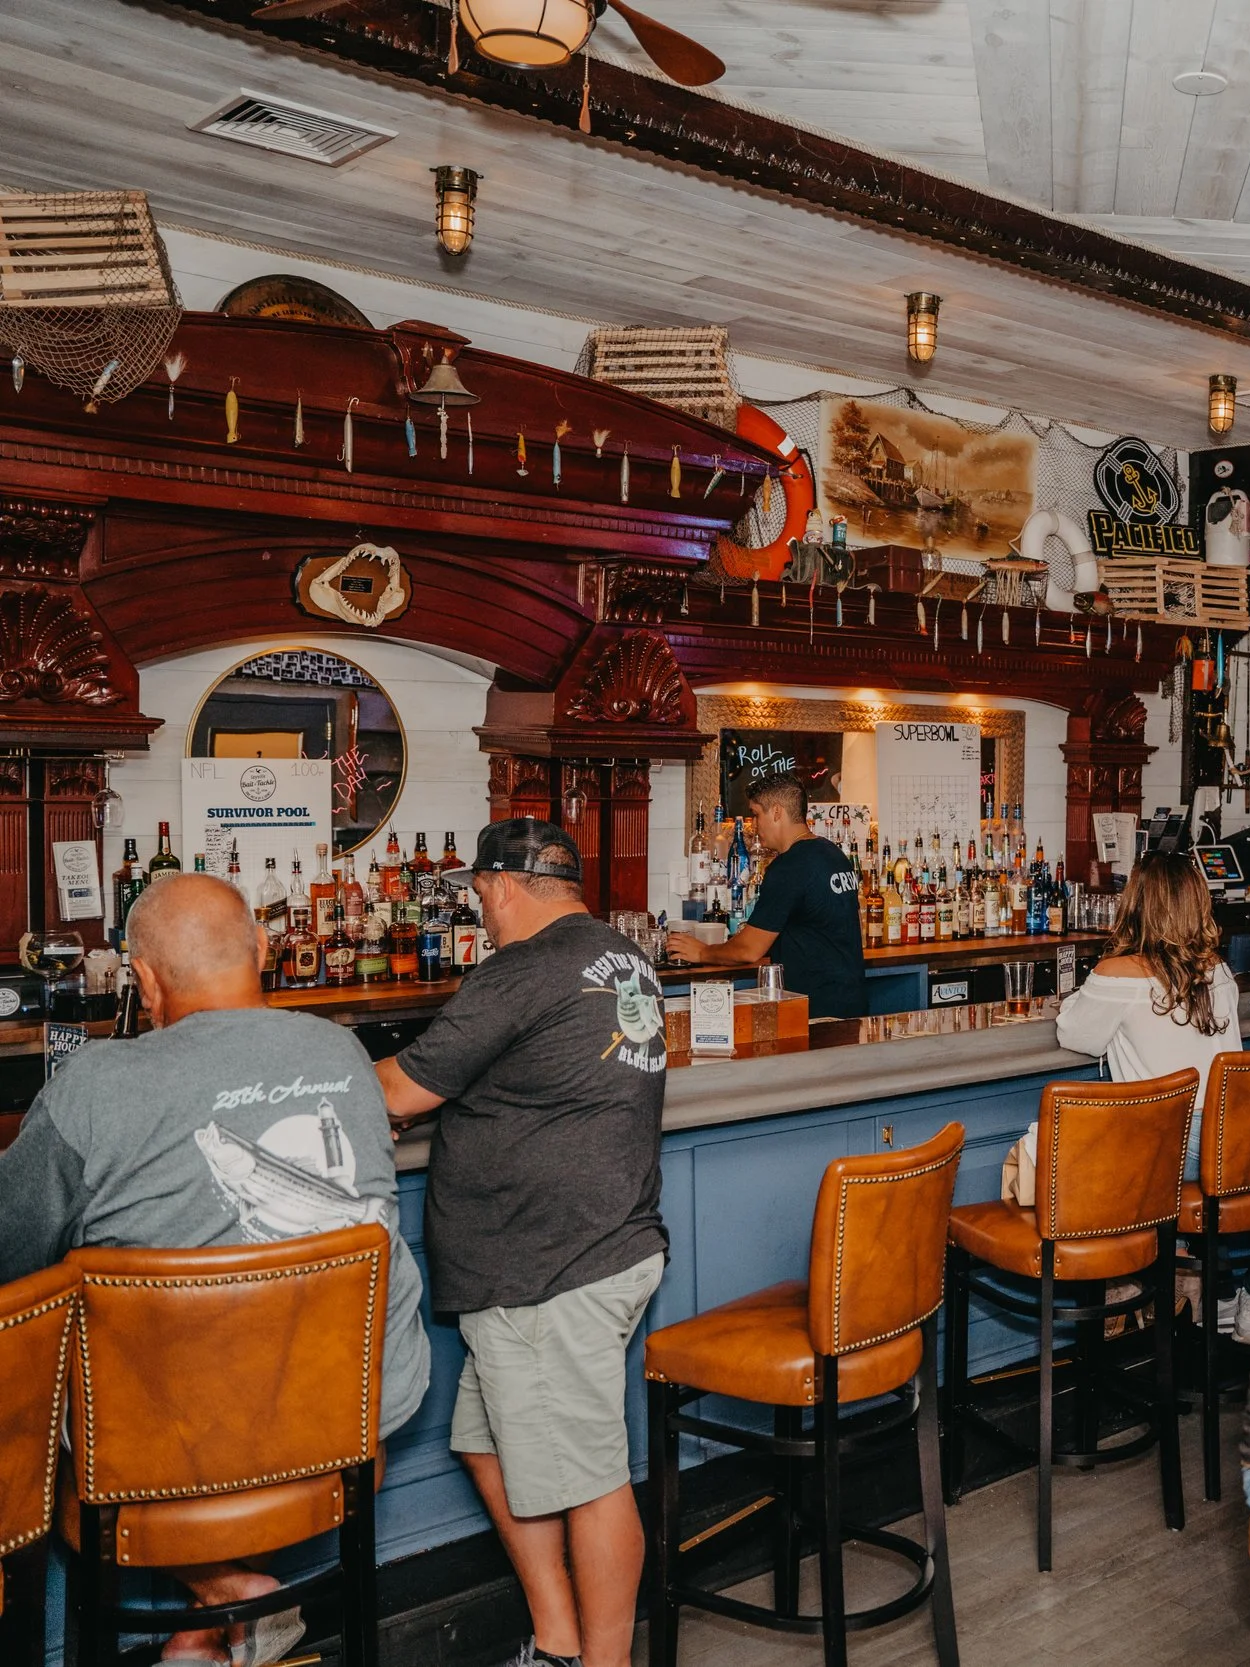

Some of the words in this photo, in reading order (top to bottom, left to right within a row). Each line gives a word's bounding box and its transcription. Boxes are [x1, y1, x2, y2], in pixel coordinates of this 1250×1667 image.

[1091, 512, 1200, 556] PACIFICO
[894, 724, 960, 741] SUPERBOWL
[331, 745, 369, 776] THE
[738, 743, 782, 766] ROLL
[191, 762, 226, 780] NFL
[751, 764, 768, 777] OF
[771, 757, 796, 773] THE
[333, 767, 369, 800] DAY
[207, 807, 274, 818] SURVIVOR
[277, 807, 310, 817] POOL
[829, 805, 850, 819] CFB
[458, 935, 476, 962] 7
[582, 956, 615, 986] FISH
[605, 950, 632, 970] THE
[934, 985, 967, 998] AVANTCO
[50, 1031, 88, 1044] HAPPY
[268, 1075, 352, 1104] Annual
